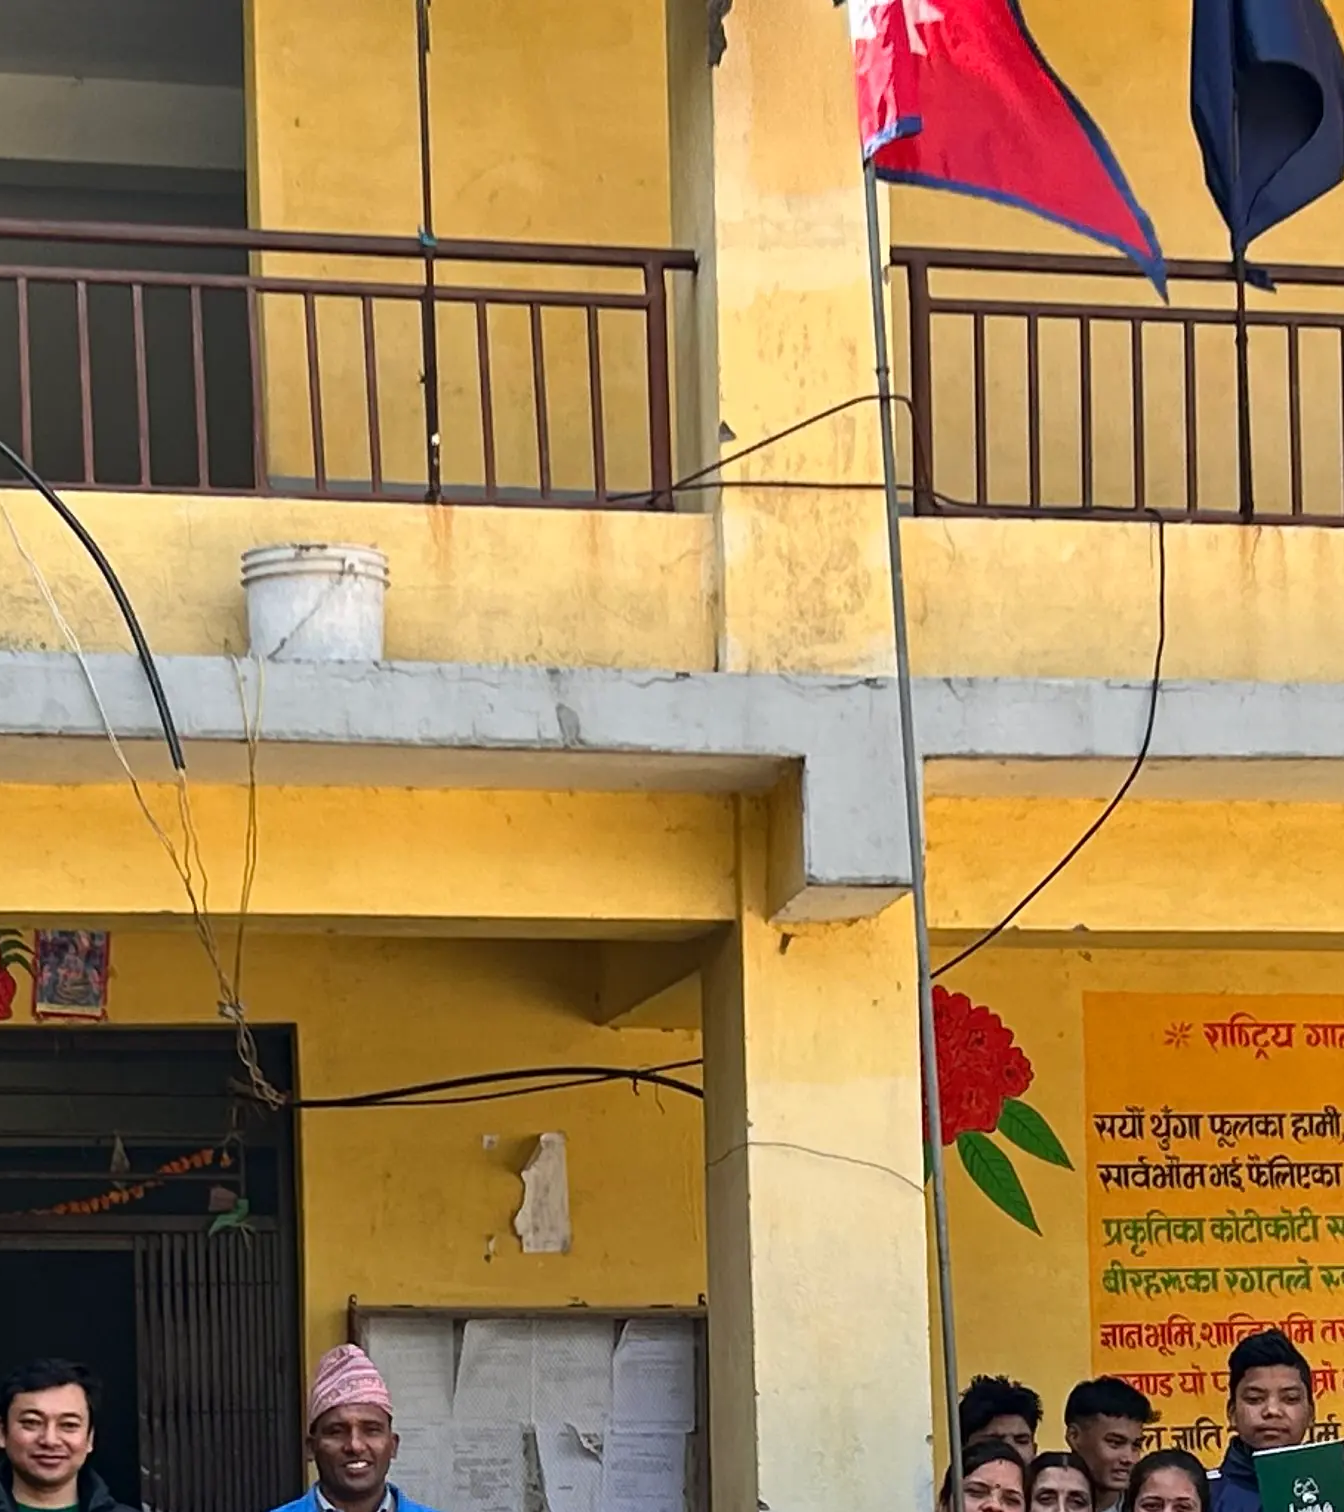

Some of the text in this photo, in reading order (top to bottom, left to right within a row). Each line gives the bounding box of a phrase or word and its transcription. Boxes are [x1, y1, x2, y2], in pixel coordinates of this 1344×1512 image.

[1207, 1114, 1286, 1148] फूलका
[1096, 1155, 1207, 1193] सार्वभौम
[1208, 1156, 1244, 1193] भई
[1102, 1208, 1207, 1257] प्रकृतिका
[1223, 1255, 1314, 1298] रगतले
[1178, 1361, 1208, 1396] यो
